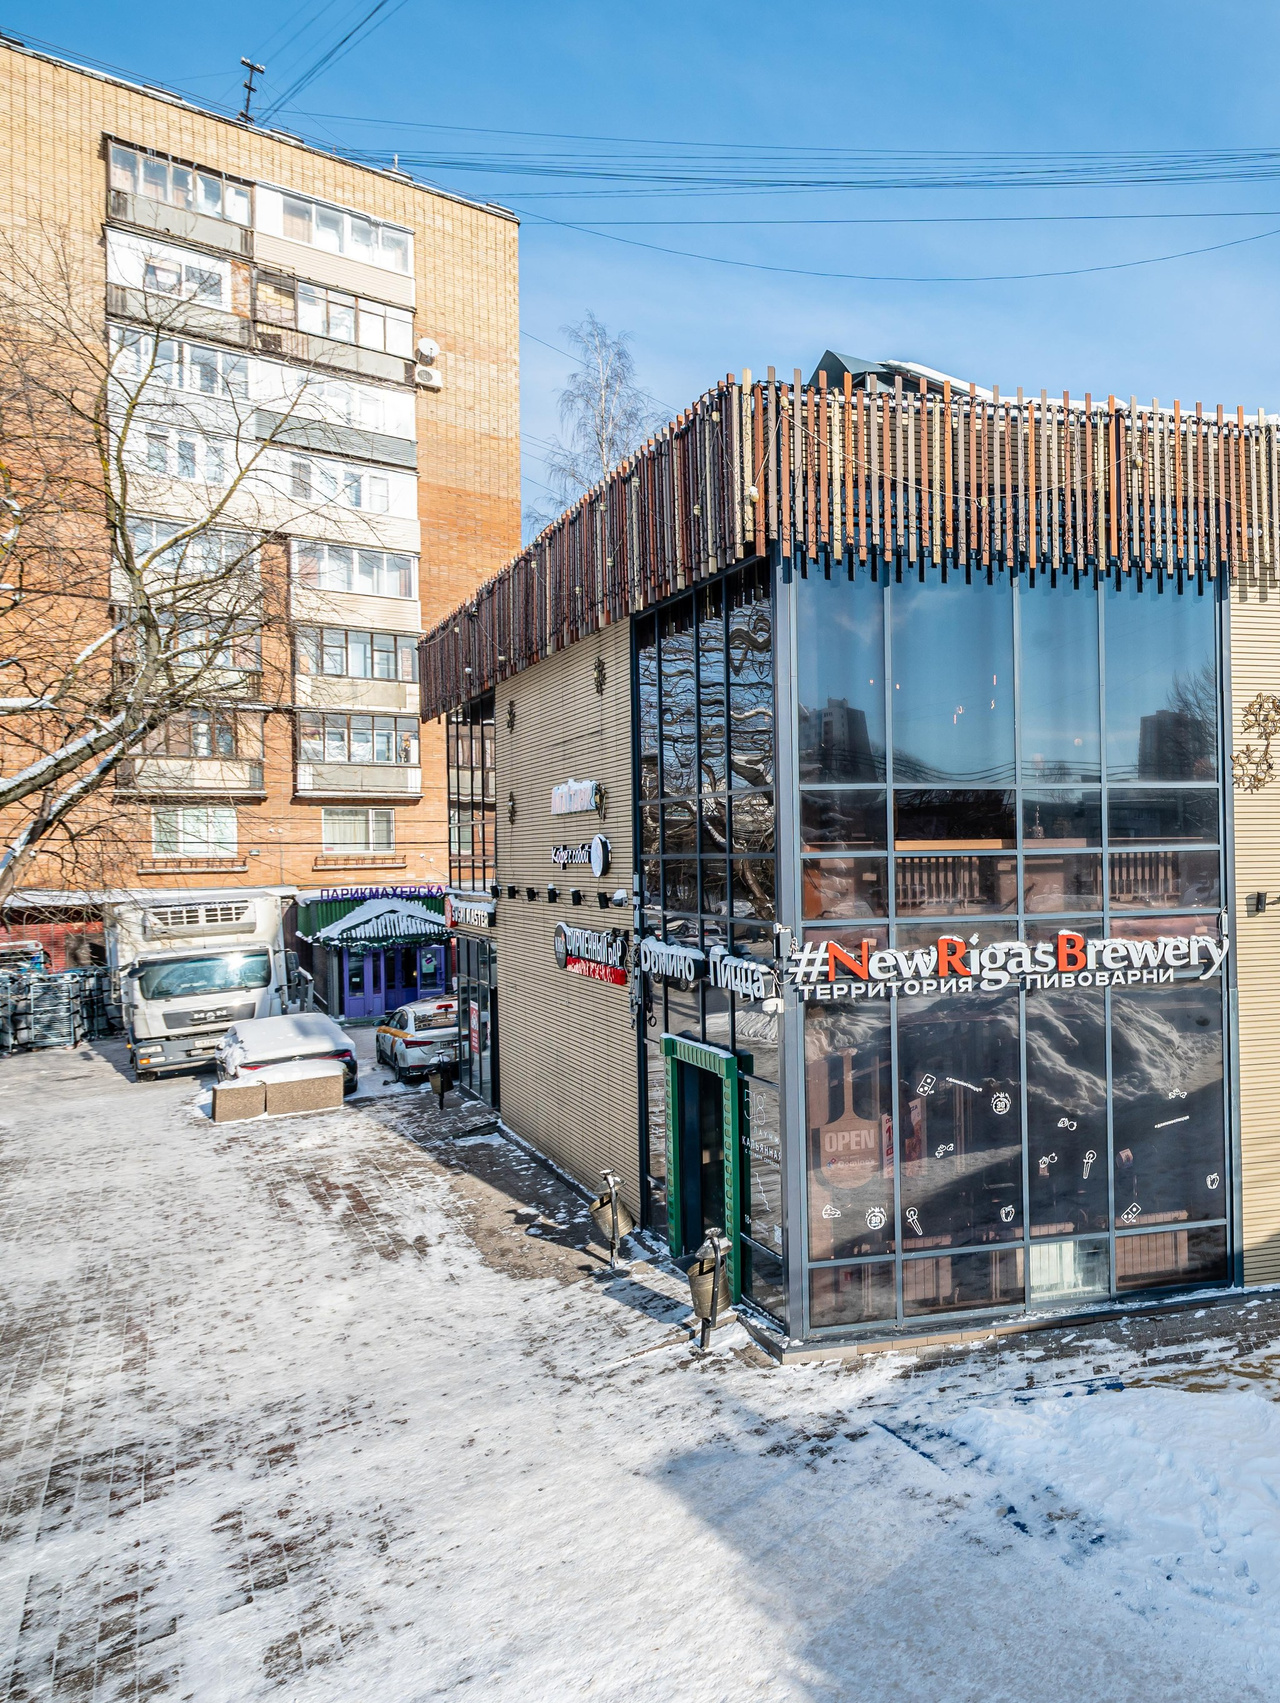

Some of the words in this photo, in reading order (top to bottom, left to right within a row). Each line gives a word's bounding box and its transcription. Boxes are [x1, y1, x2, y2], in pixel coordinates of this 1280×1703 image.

[320, 884, 449, 901] ПАРИКМАХЕРСКА
[789, 931, 1230, 992] #NewRigasBrewery
[709, 953, 765, 1002] Пицца
[799, 977, 973, 1000] ТЕРРИТОРИЯ
[1026, 968, 1175, 989] ПИВОВАРНИ
[193, 1009, 227, 1019] MAN
[824, 1129, 875, 1152] OPEN
